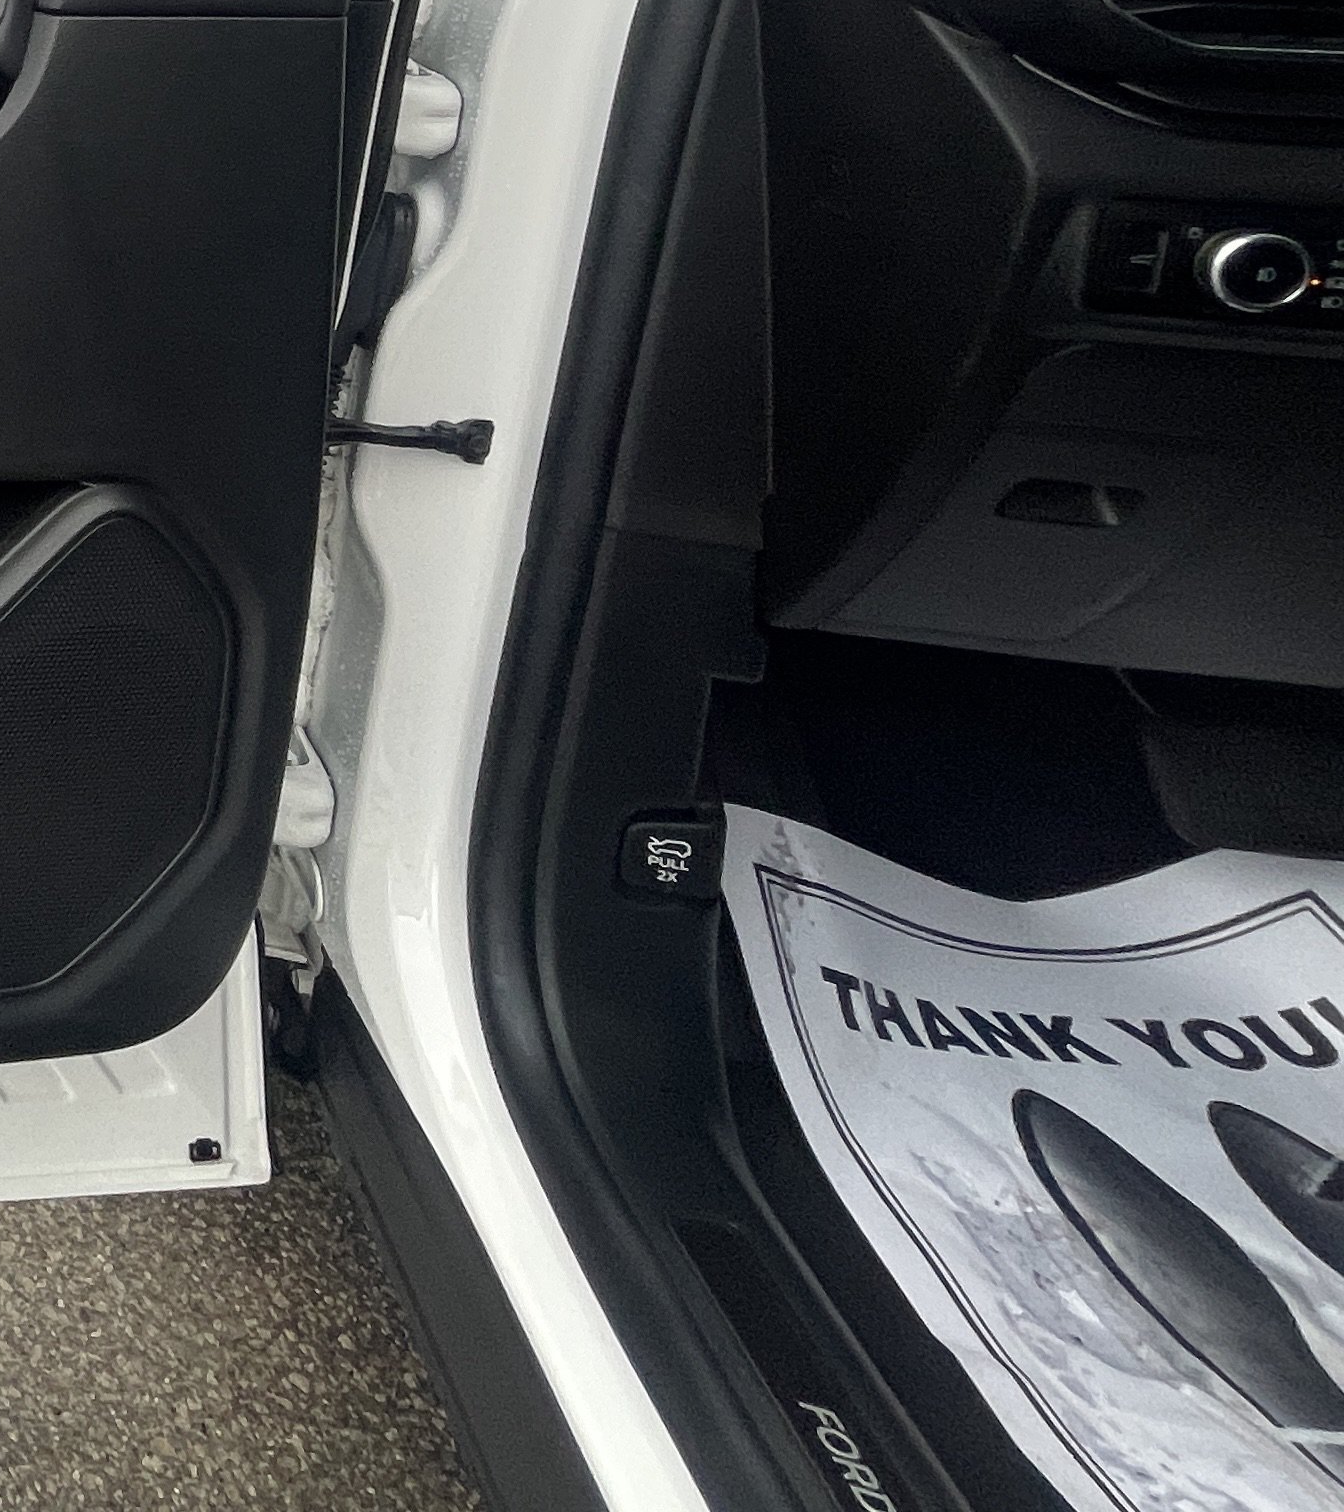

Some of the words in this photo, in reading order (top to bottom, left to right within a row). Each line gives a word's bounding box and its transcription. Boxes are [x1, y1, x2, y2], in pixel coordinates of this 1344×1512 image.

[648, 855, 690, 872] PULL
[819, 965, 1123, 1066] THANK
[797, 1401, 897, 1512] FORD
